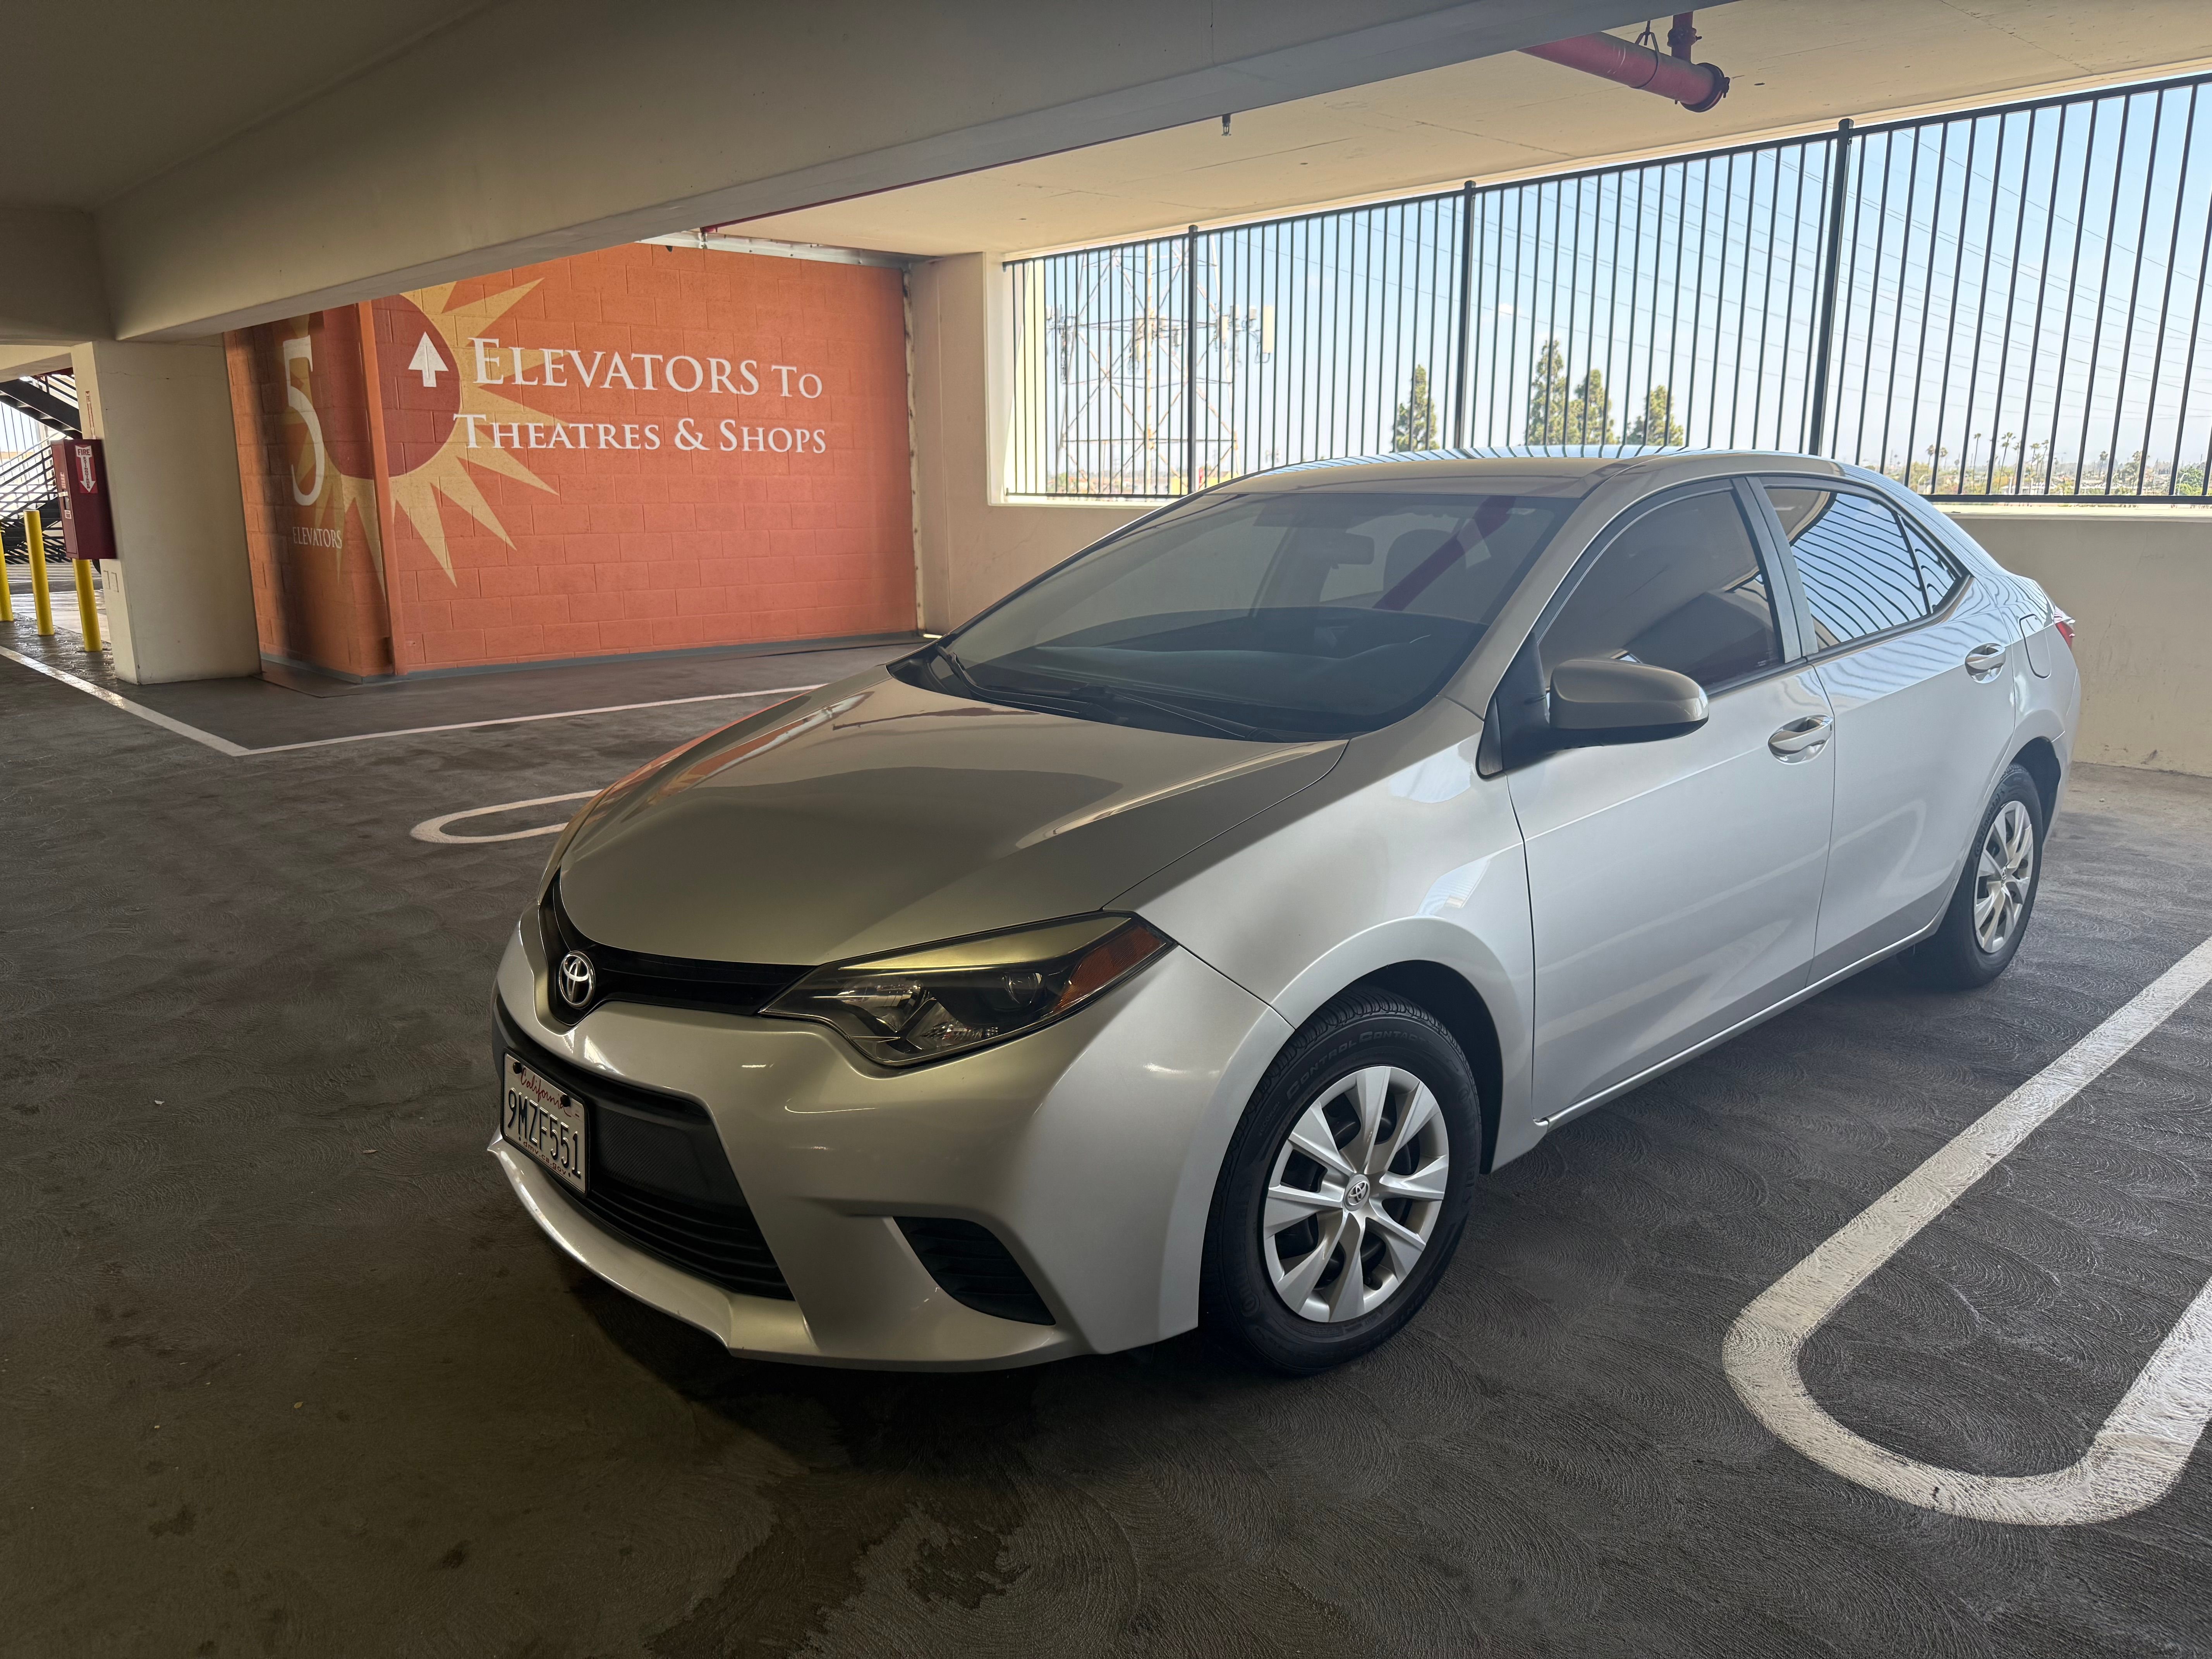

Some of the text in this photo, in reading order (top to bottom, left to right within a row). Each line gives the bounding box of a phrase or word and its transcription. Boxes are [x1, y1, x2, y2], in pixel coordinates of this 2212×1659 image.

[468, 337, 759, 395] ELEVATORS
[283, 335, 325, 505] 5
[453, 413, 826, 453] THEATRES & SHOPS
[293, 527, 342, 549] ELEVATORS
[508, 1087, 581, 1179] 9MZF551
[524, 1141, 566, 1175] dmv.ca.gov
